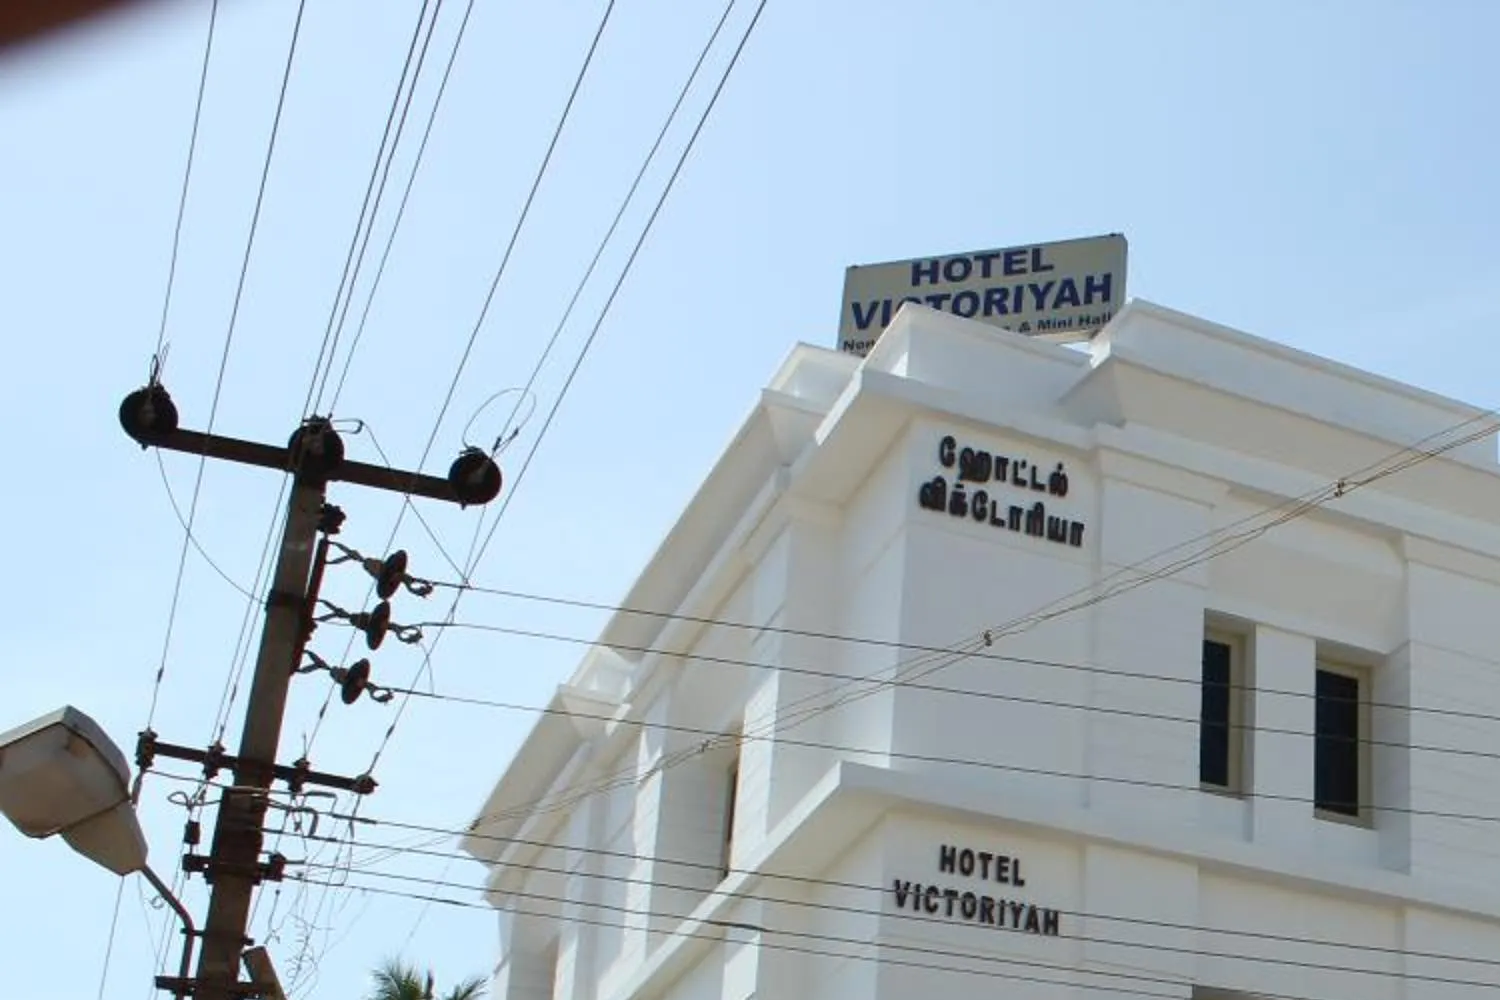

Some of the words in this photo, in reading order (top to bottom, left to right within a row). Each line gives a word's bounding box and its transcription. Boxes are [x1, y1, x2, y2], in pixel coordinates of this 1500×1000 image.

[911, 247, 1055, 286] HOTEL
[851, 272, 1112, 330] VITORIYAH
[1037, 317, 1073, 331] Mini
[939, 435, 1069, 498] ஹோட்டல்
[919, 475, 1085, 548] விக்டோரியா
[939, 844, 1026, 887] HOTEL
[893, 879, 1060, 936] VICTORIYAH
